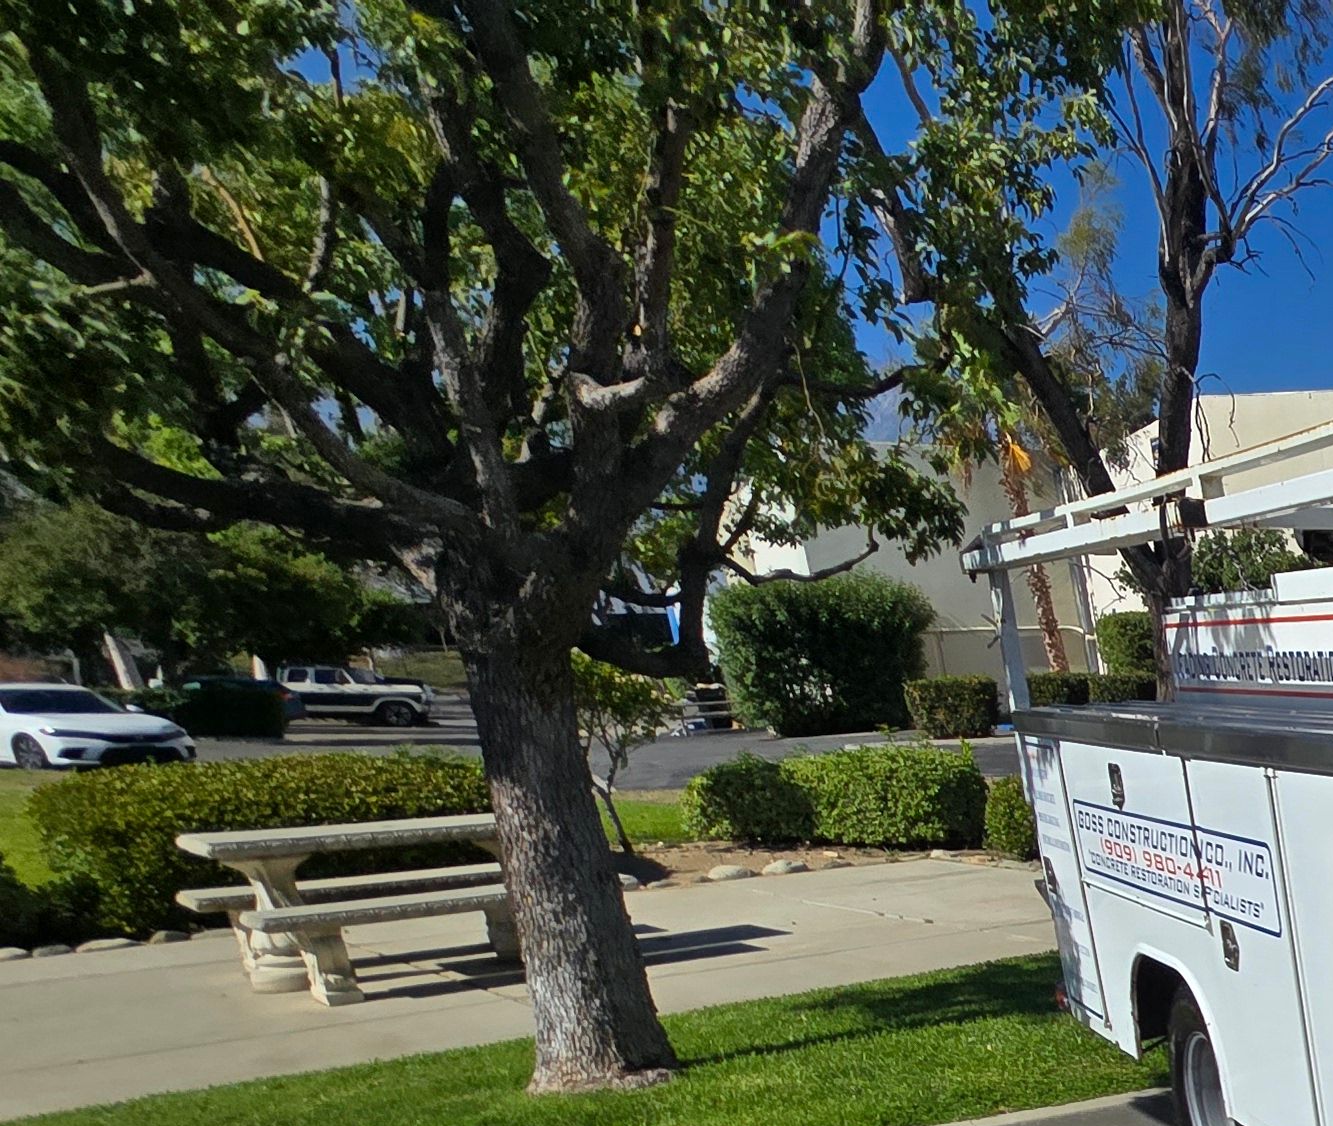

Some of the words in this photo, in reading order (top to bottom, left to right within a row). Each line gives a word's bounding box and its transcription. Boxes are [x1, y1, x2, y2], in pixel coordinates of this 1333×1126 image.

[1211, 646, 1266, 682] CONCRETE
[1077, 809, 1105, 835] GOSS
[1106, 817, 1204, 860] CONSTRUCTION
[1237, 848, 1270, 880] INC.
[1100, 836, 1138, 865] (909)
[1131, 863, 1190, 897] RESTORATION
